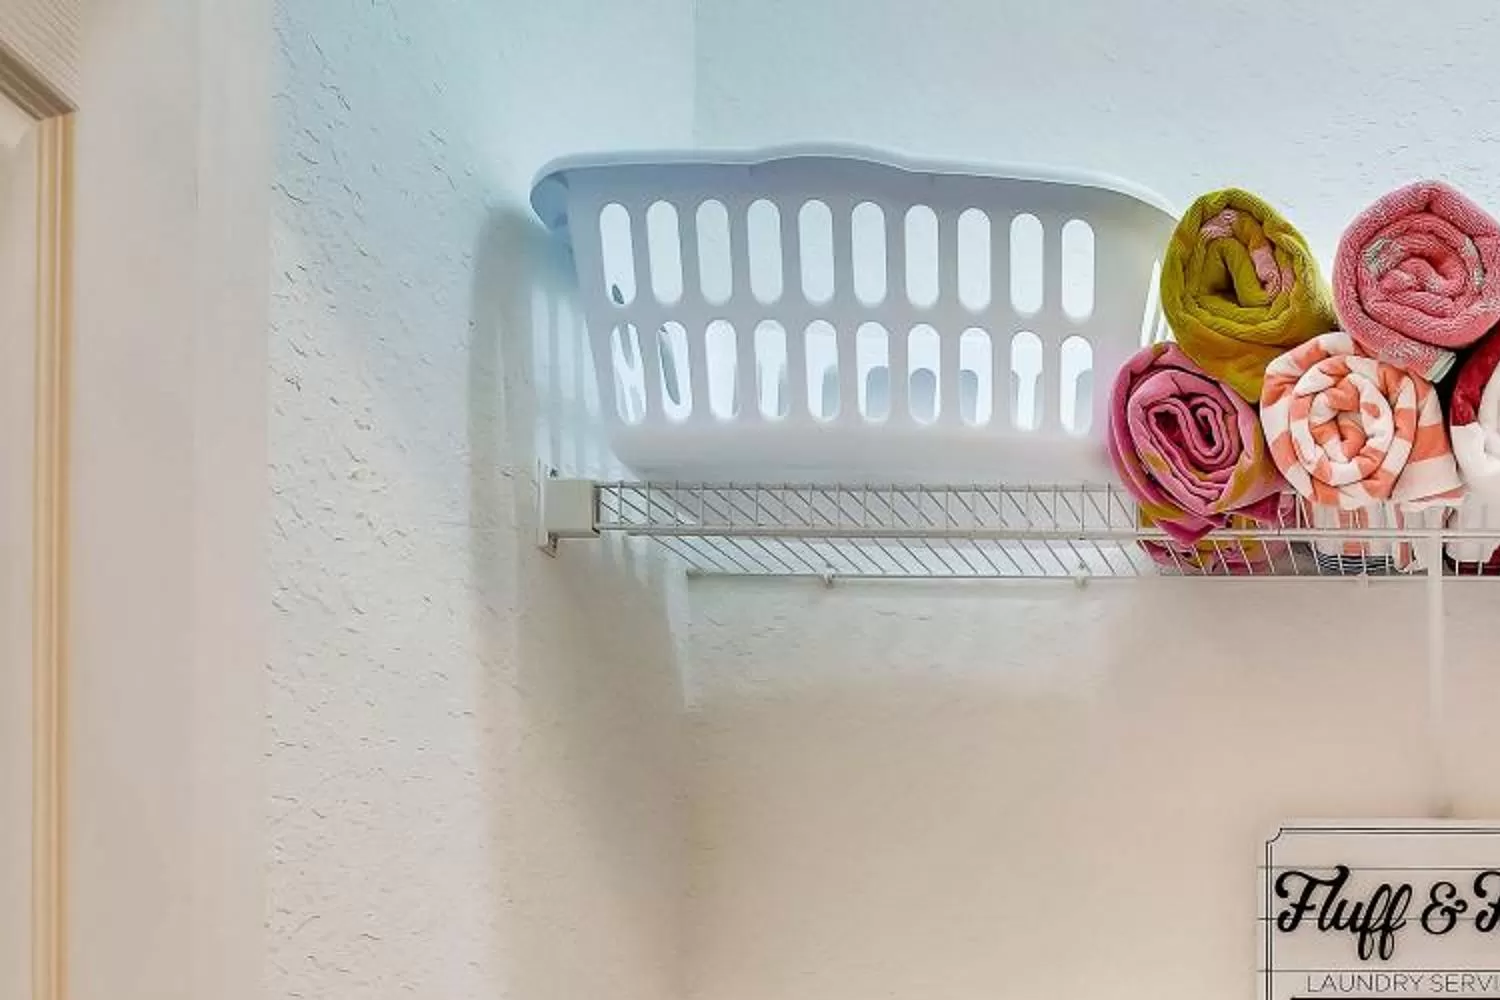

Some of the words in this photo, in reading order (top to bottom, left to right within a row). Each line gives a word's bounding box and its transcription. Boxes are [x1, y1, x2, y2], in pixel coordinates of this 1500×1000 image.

[1275, 865, 1413, 961] Fluff
[1421, 881, 1468, 935] &
[1306, 974, 1423, 993] LAUNDRY
